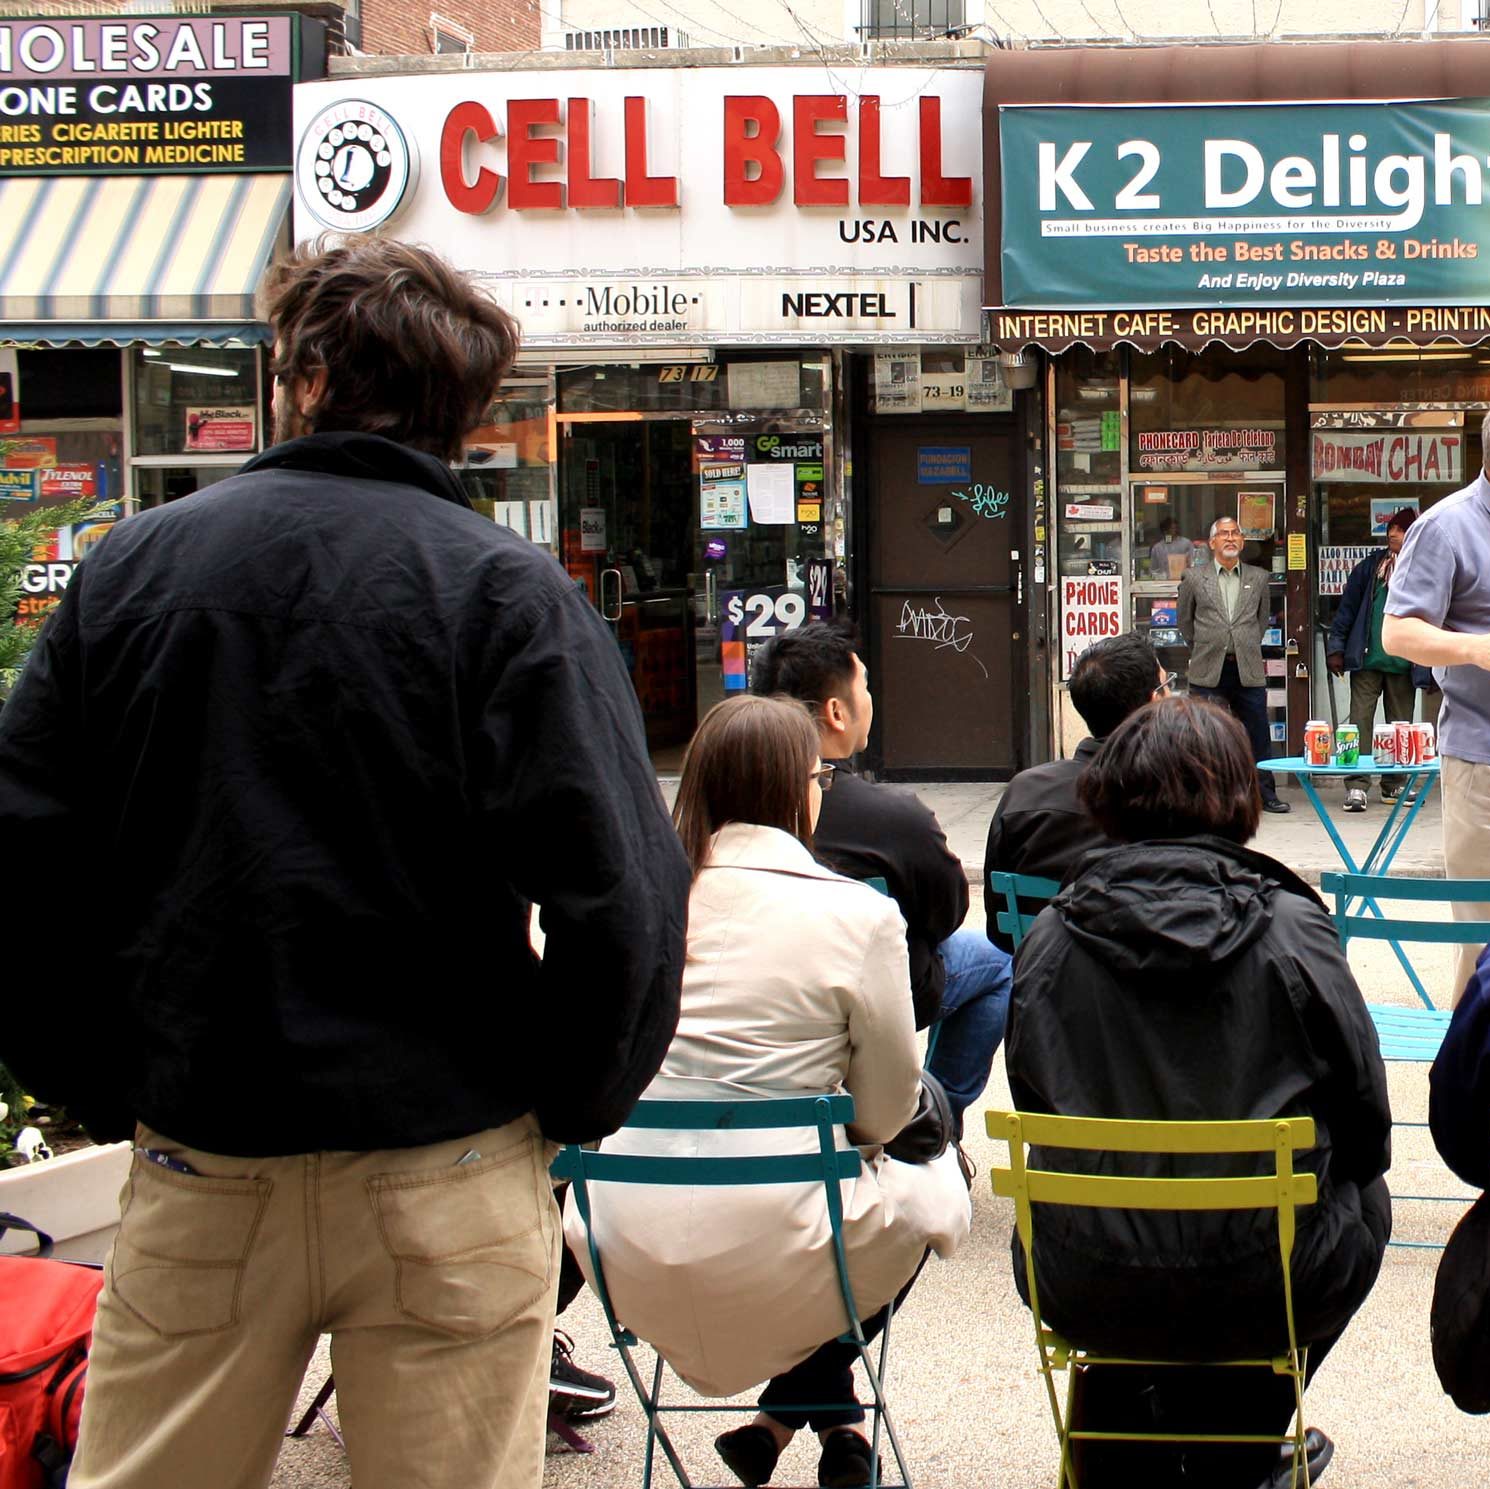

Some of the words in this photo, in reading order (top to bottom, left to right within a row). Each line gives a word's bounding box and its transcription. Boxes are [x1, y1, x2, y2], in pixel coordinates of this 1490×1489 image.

[90, 83, 213, 114] CARDS
[52, 122, 158, 141] CIGARETTE
[164, 121, 243, 139] LIGHTER
[1, 146, 139, 166] PRESCRIPTION
[145, 145, 245, 163] MEDICINE
[439, 96, 680, 215] CELL
[724, 95, 972, 209] BELL
[1038, 142, 1095, 212] K
[1114, 140, 1161, 210] 2
[839, 220, 898, 244] USA
[911, 220, 970, 244] INC.
[1046, 223, 1080, 233] Small
[1085, 223, 1138, 232] business
[1143, 223, 1187, 231] creates
[1193, 221, 1212, 232] Big
[1218, 221, 1281, 232] Happiness
[1287, 220, 1305, 229] for
[1311, 220, 1331, 229] the
[1336, 219, 1392, 230] Diversity
[1124, 243, 1183, 263] Taste
[1190, 241, 1227, 262] the
[1235, 241, 1284, 261] Best
[1290, 239, 1368, 261] Snacks
[1375, 240, 1396, 260] &
[1404, 238, 1478, 260] Drinks
[1198, 273, 1232, 289] And
[1236, 273, 1283, 291] Enjoy
[1286, 272, 1359, 290] Diversity
[1362, 271, 1406, 286] Plaza
[585, 285, 688, 316] Mobile
[782, 293, 896, 318] NEXTEL
[583, 319, 647, 332] authorized
[649, 319, 687, 331] dealer
[999, 314, 1107, 339] INTERNET
[1192, 311, 1294, 335] GRAPHIC
[1301, 310, 1386, 334] DESIGN
[923, 385, 964, 399] 73-19
[722, 438, 745, 447] 1,000
[771, 443, 822, 458] smart
[1139, 432, 1200, 449] PHONECARD
[1203, 430, 1232, 449] Tarjeta
[1231, 430, 1241, 448] De
[1241, 429, 1276, 447] Telefono
[1313, 435, 1385, 480] BOMBAY
[1387, 436, 1460, 481] CHAT
[41, 468, 94, 480] TYLENOL
[22, 563, 78, 593] GR
[1066, 581, 1118, 605] PHONE
[727, 593, 806, 637] $29
[1066, 611, 1120, 636] CARDS
